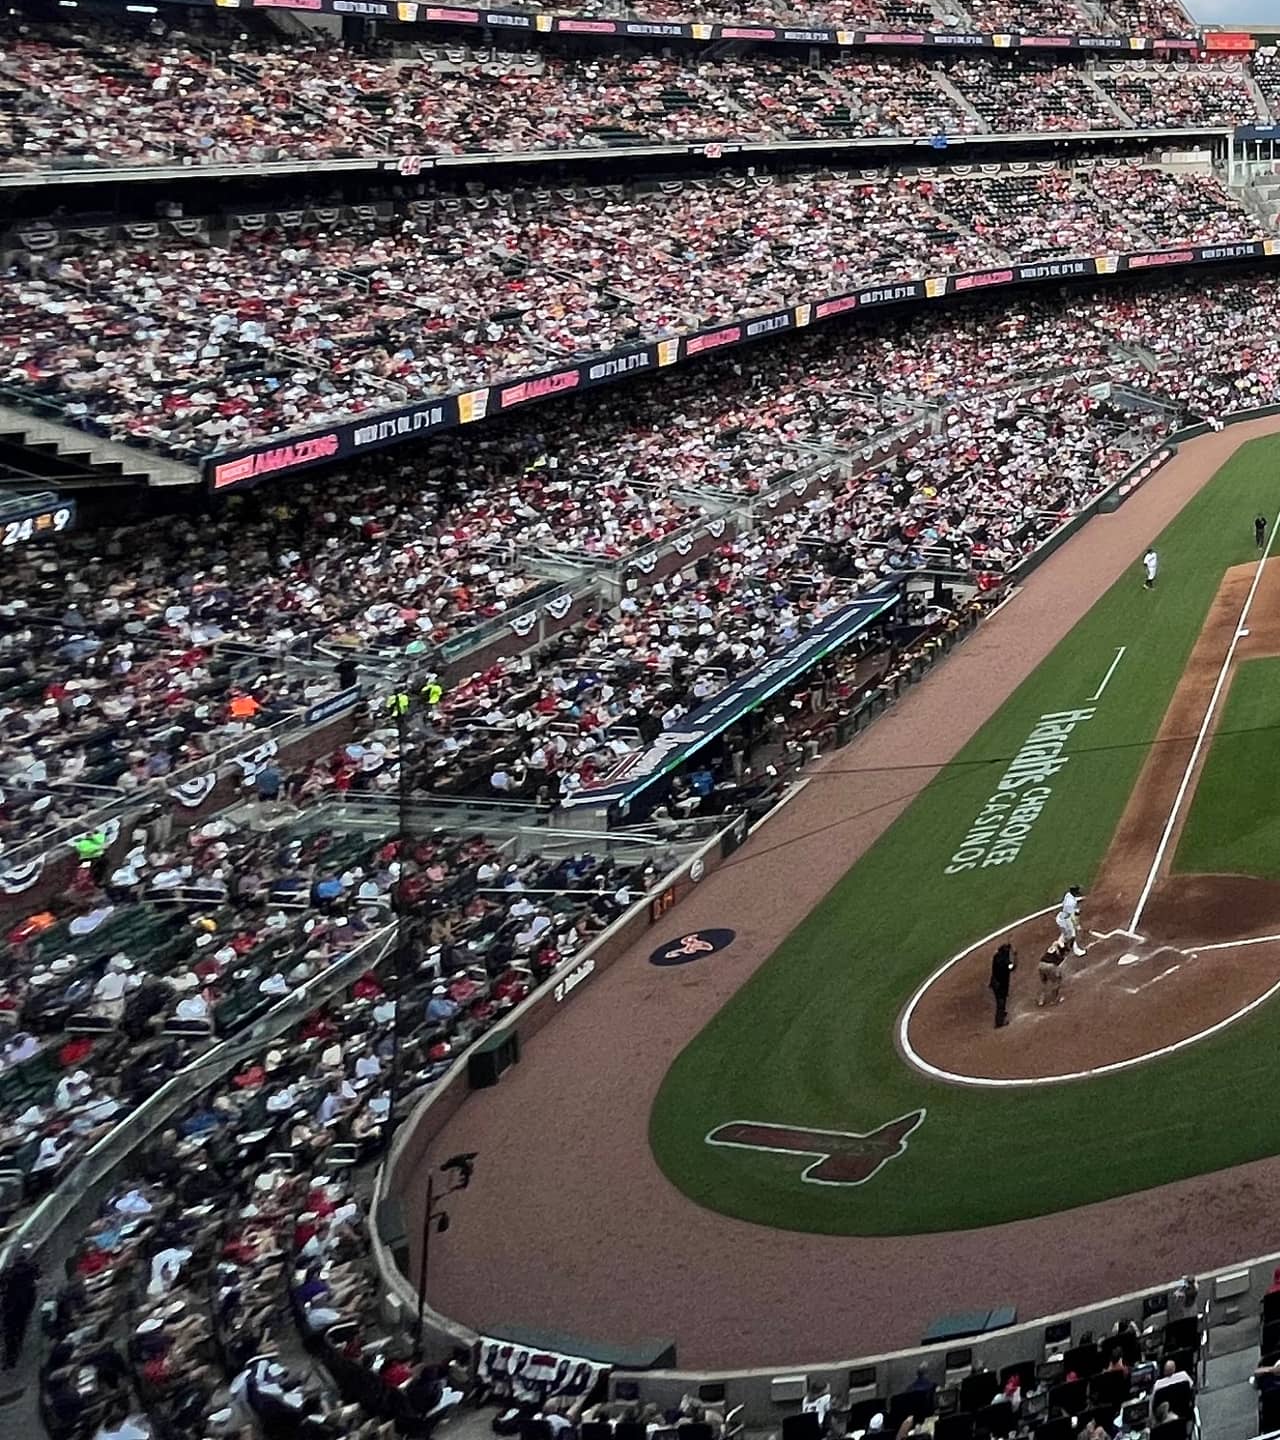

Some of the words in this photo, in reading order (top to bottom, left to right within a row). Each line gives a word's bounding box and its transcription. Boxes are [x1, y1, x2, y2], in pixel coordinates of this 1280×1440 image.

[2, 518, 33, 546] 24
[54, 509, 70, 532] 9
[944, 791, 1017, 874] CASINOS
[981, 787, 1052, 868] CHEROKEE
